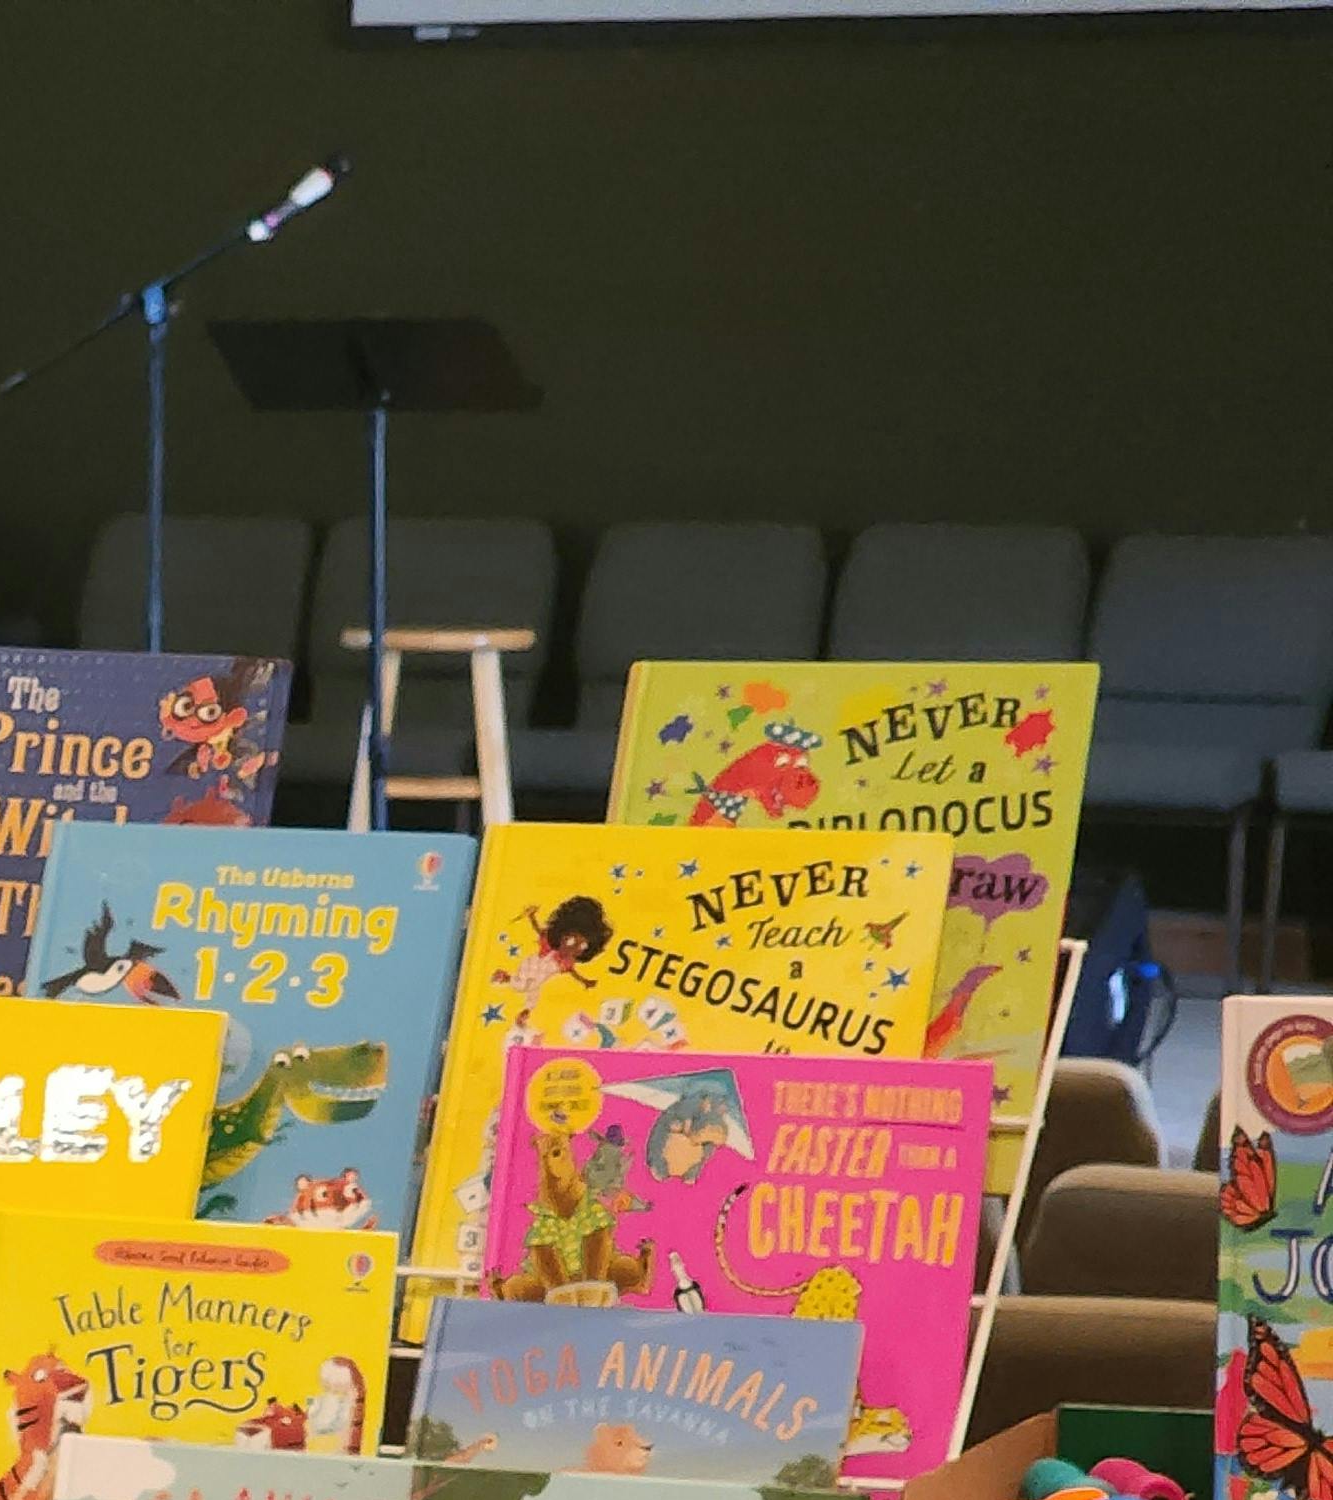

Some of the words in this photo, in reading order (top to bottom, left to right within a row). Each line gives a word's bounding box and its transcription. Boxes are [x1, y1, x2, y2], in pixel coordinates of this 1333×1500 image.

[6, 675, 62, 714] The
[839, 692, 1022, 765] NEVER
[53, 781, 86, 801] and
[89, 781, 118, 803] the
[891, 751, 958, 784] Let
[968, 759, 986, 784] a
[215, 865, 256, 887] The
[262, 867, 355, 890] Usborne
[688, 860, 870, 931] NEVER
[151, 881, 399, 954] Rhyming
[747, 916, 853, 951] Teach
[789, 958, 803, 979] a
[608, 938, 895, 1056] STEGOSAURUS
[774, 1080, 859, 1118] THERE'S
[864, 1083, 963, 1124] NOTHING
[766, 1121, 894, 1180] FASTER
[944, 1146, 958, 1169] A
[747, 1180, 965, 1268] CHEETAH
[54, 1286, 144, 1337] Table
[157, 1279, 313, 1343] Manners
[163, 1328, 198, 1360] for
[85, 1343, 268, 1421] Tigers
[453, 1343, 582, 1415] YOGA
[597, 1340, 819, 1442] ANIMALS
[564, 1397, 608, 1420] THE
